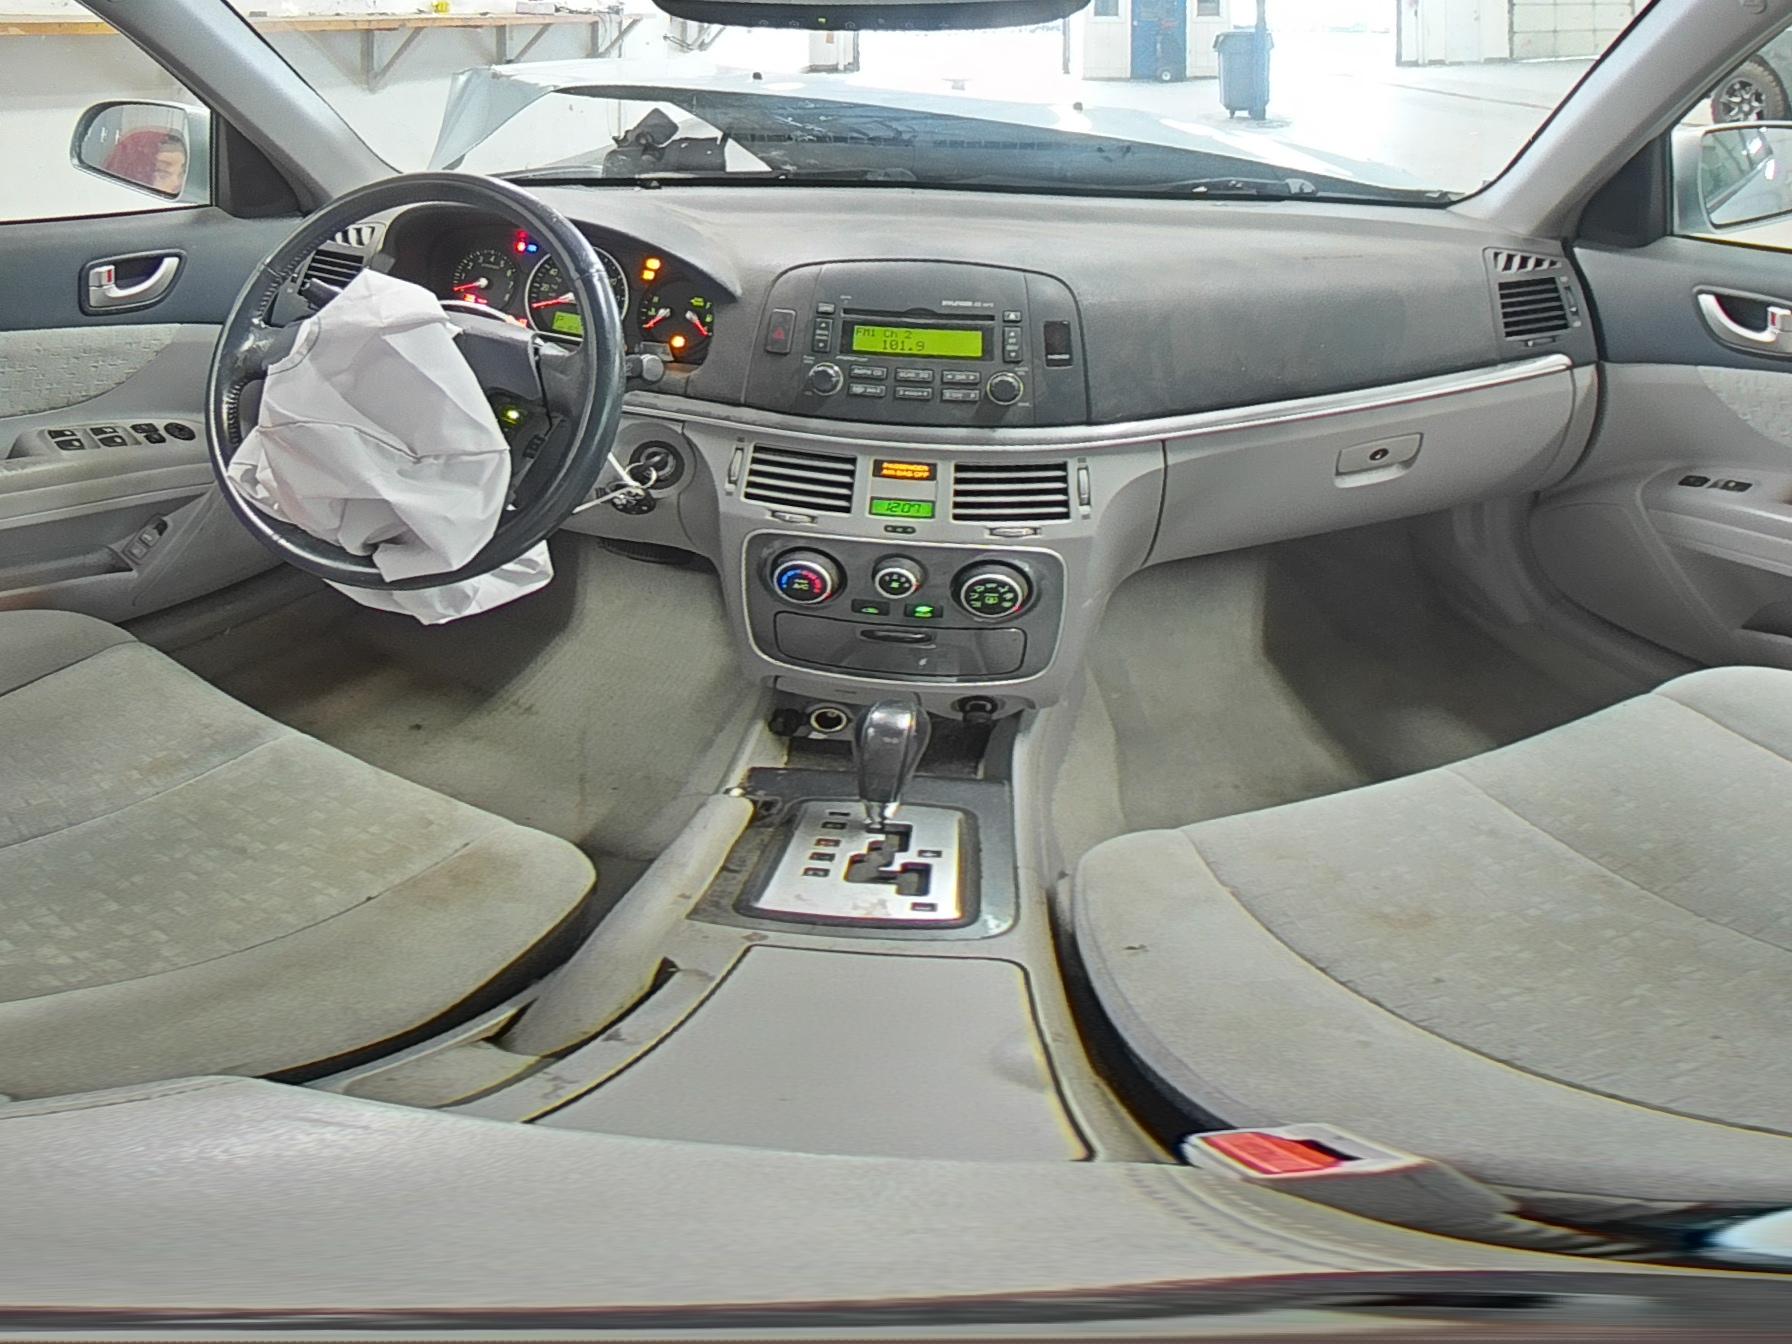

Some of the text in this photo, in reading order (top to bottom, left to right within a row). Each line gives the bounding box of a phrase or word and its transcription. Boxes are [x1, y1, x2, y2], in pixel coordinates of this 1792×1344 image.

[855, 328, 912, 339] FM1 Ch 2
[882, 340, 925, 351] 101.9
